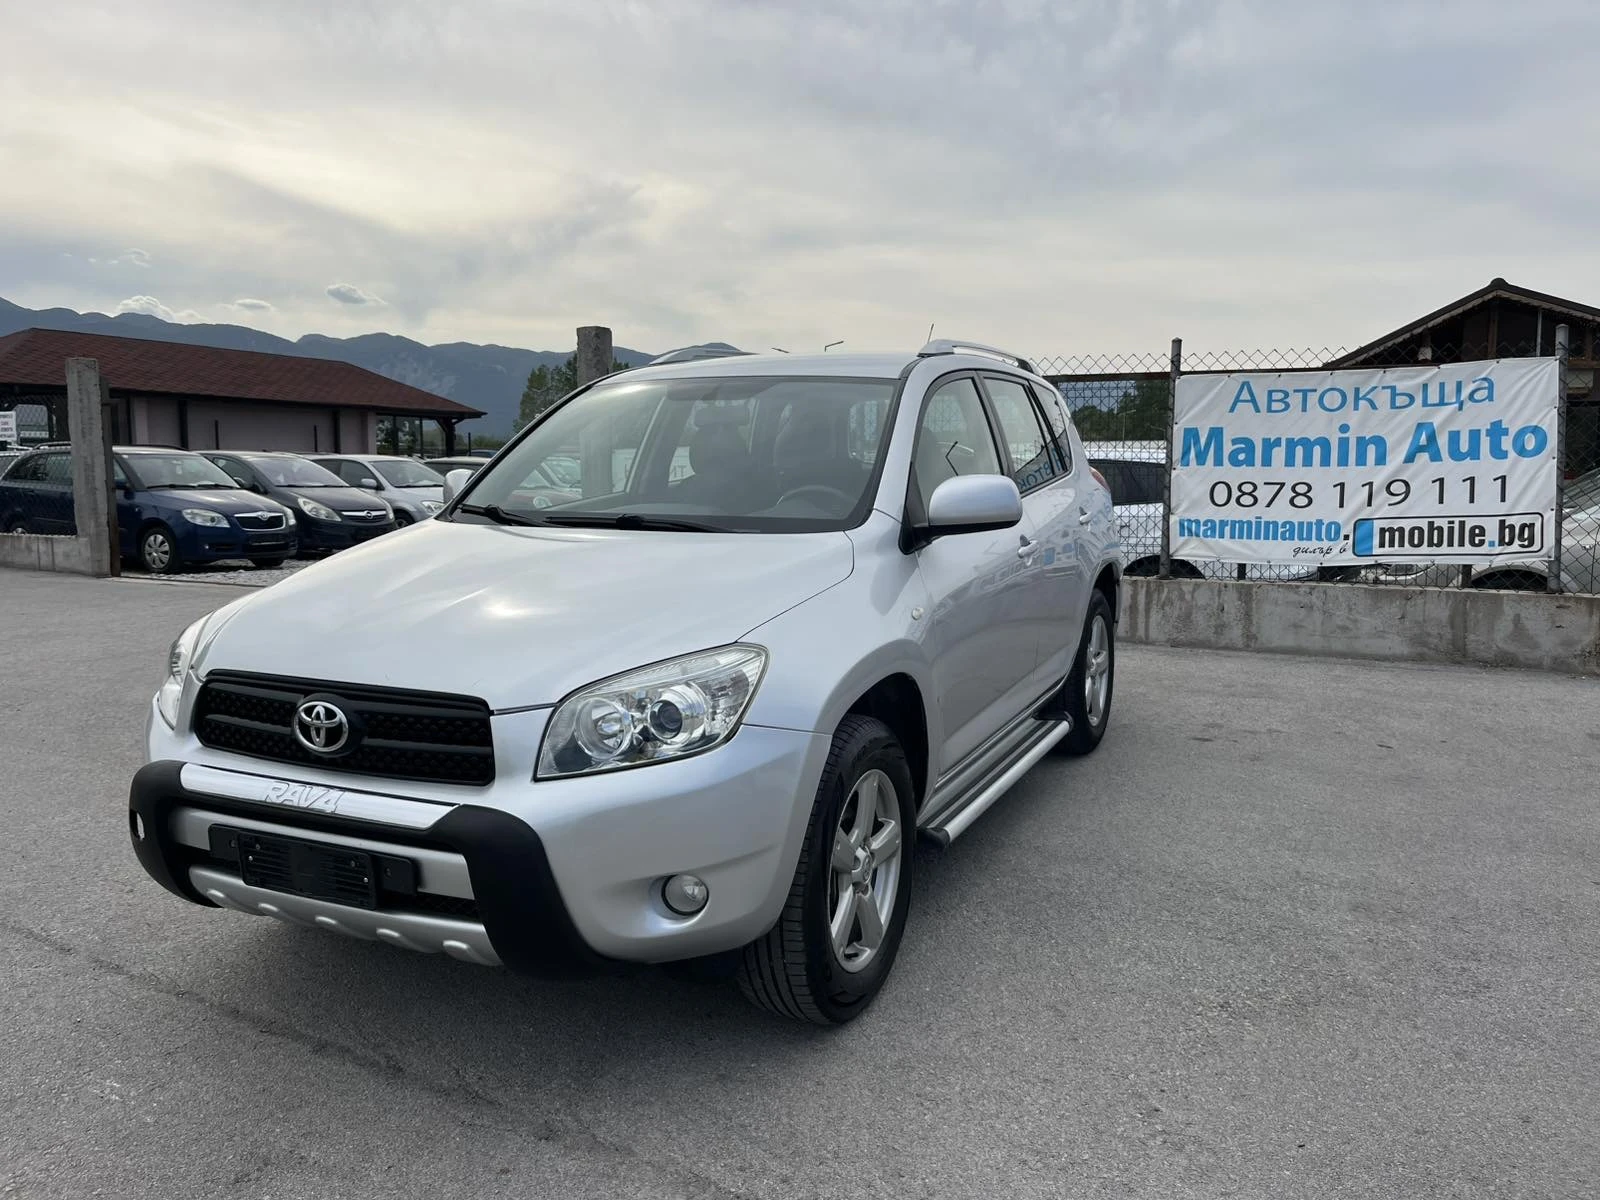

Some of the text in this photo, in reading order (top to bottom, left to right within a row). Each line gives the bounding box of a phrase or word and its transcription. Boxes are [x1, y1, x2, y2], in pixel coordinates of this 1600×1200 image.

[1228, 376, 1495, 413] Автокъща
[1180, 419, 1548, 467] Marmin Auto
[1209, 475, 1507, 509] 0878 119 111
[1378, 519, 1536, 549] mobile.bg
[265, 781, 346, 814] RAV4
